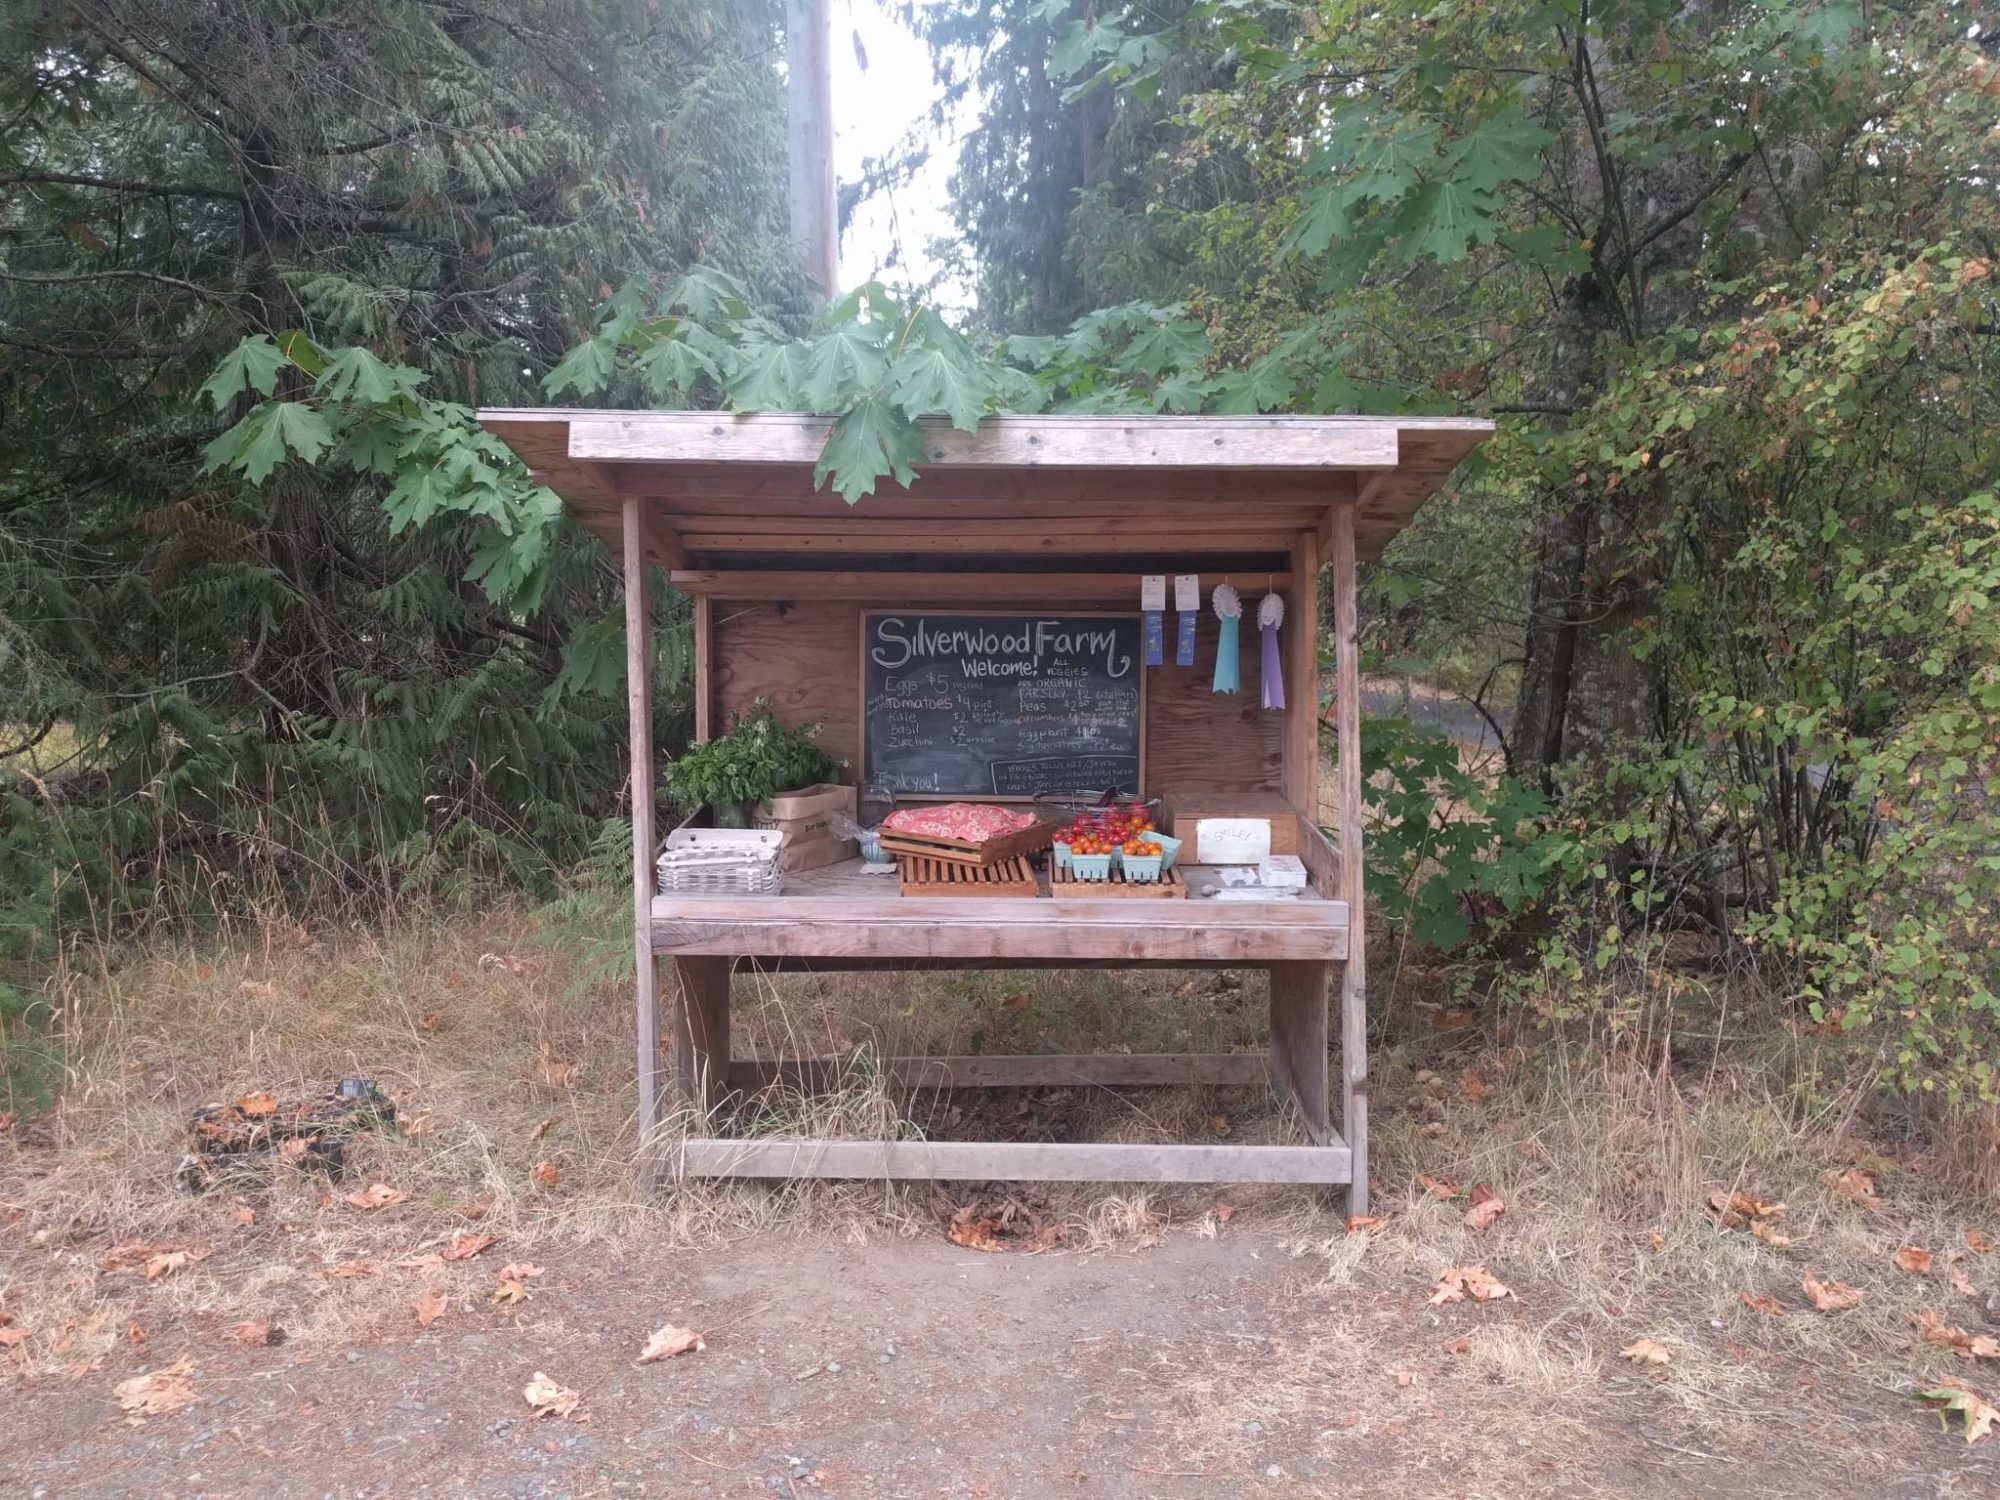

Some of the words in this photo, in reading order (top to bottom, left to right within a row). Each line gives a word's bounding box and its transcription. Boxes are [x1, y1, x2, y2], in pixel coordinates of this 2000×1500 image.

[1035, 620, 1131, 678] Farm
[961, 654, 1038, 678] Welcome!
[1053, 658, 1070, 666] ALL
[885, 676, 919, 697] Eggs
[926, 671, 951, 695] $5
[1036, 677, 1087, 688] ORGANIC
[973, 699, 993, 712] pint
[1019, 699, 1047, 713] Peas
[889, 710, 919, 724] Kale
[891, 722, 920, 736] Basil
[888, 735, 934, 748] Zucchini
